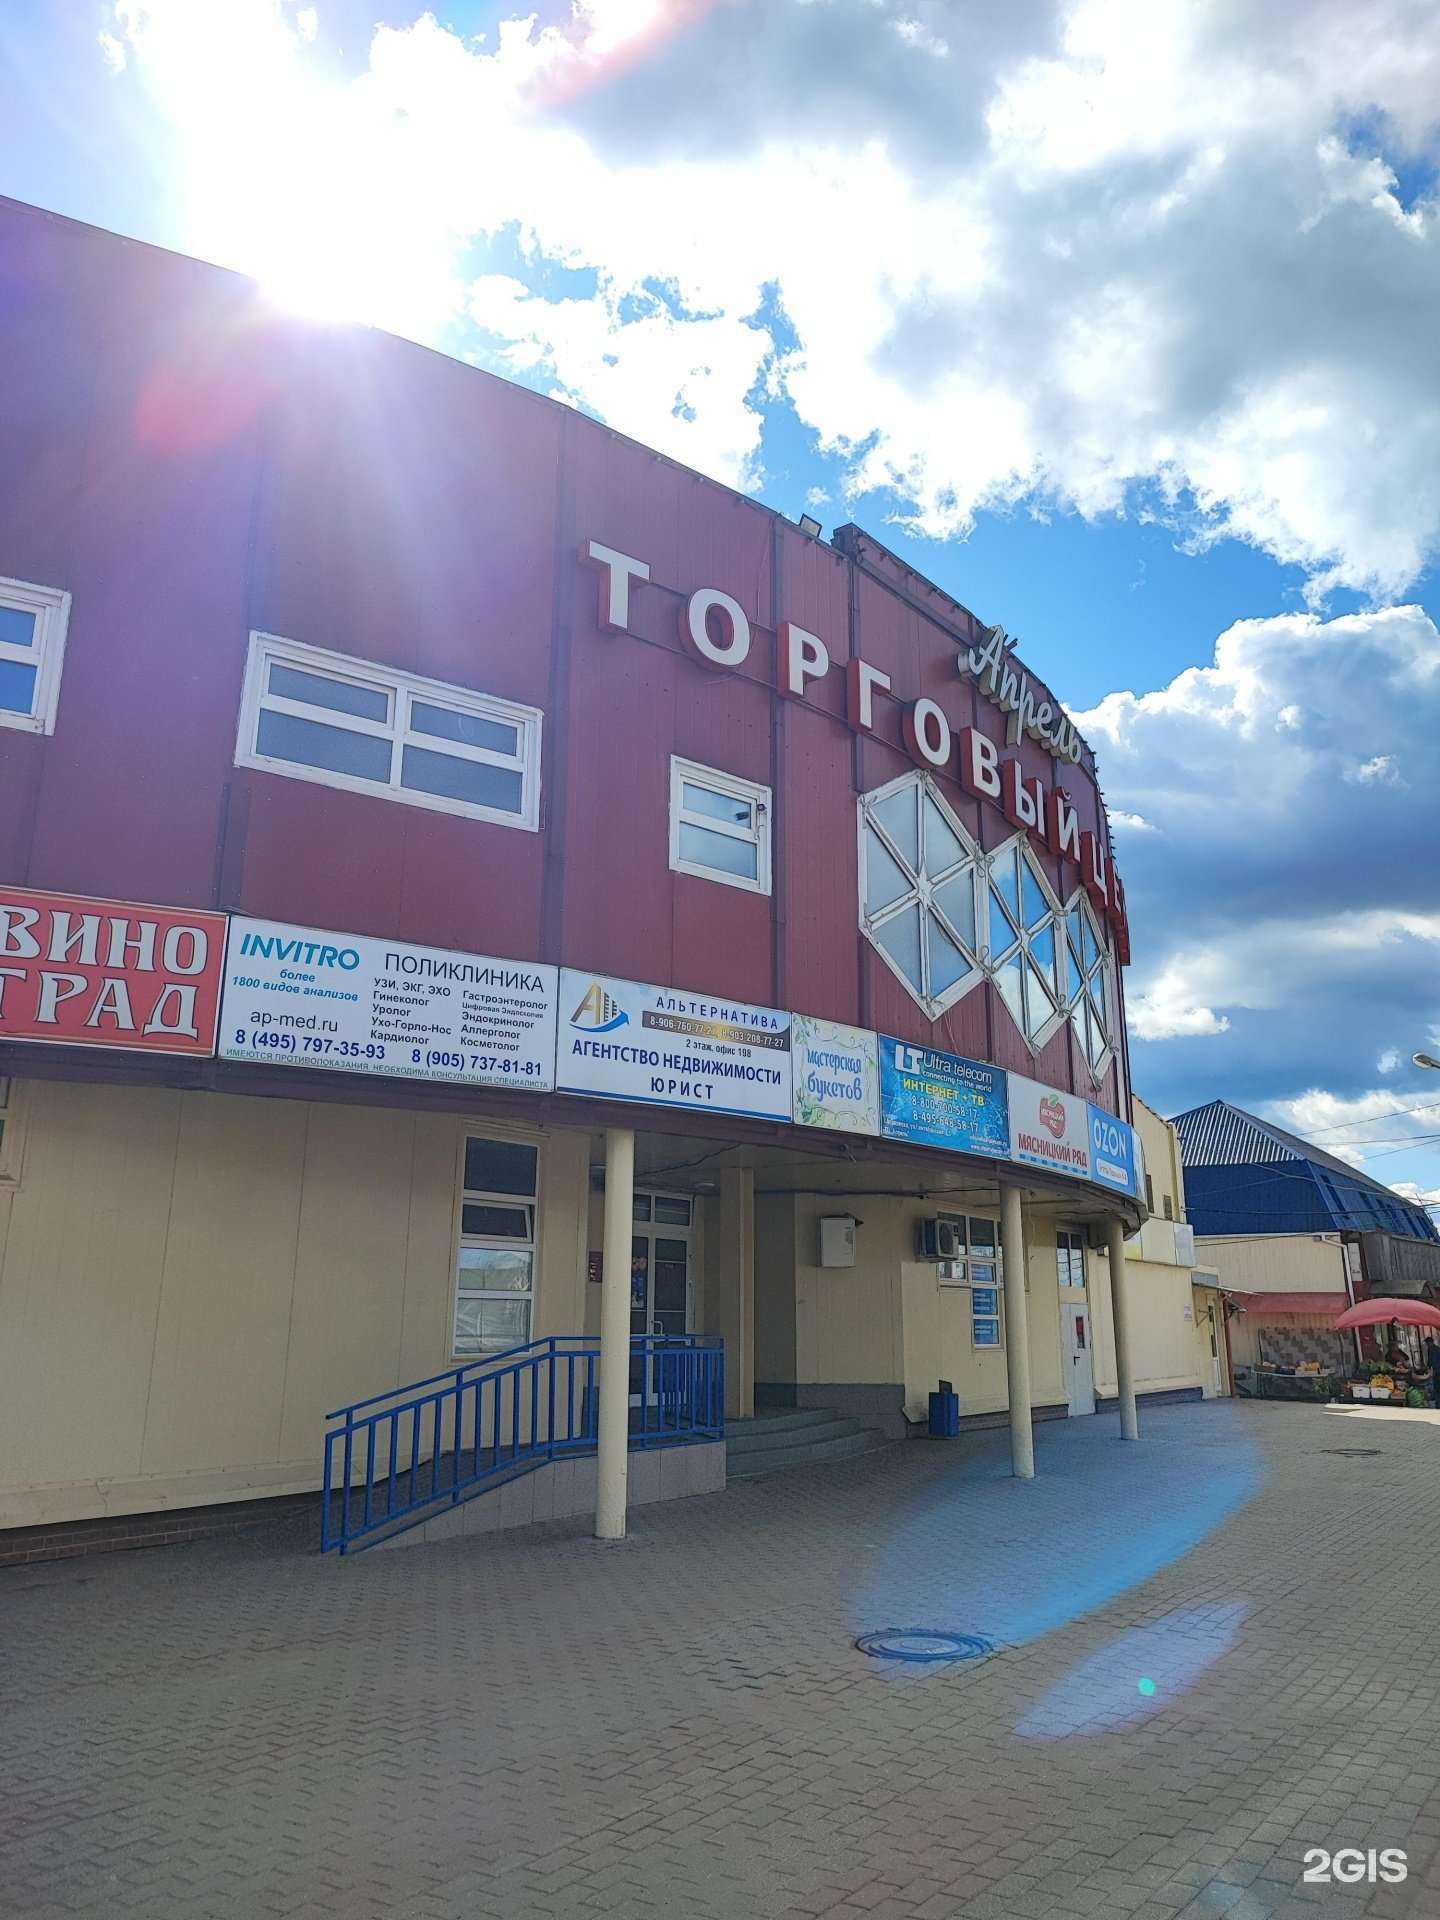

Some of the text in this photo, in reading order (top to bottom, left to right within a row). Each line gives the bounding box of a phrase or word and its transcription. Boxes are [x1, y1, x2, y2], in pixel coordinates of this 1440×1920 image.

[585, 540, 1081, 864] ТОРГОВЫЙ
[964, 624, 1082, 764] Апрель
[0, 904, 208, 976] ВИНО
[240, 933, 360, 970] INVITRO
[279, 968, 316, 983] более
[385, 953, 545, 993] ПОЛИКЛИНИКА
[232, 976, 359, 1002] 1800 видов анализов
[373, 990, 430, 1006] Гинеколог
[374, 977, 451, 997] УЗИ, ЭКГ, ЭХО
[463, 990, 548, 1010] Гастроэнтеролог
[372, 1003, 411, 1017] Уролог
[462, 1002, 500, 1014] Цифровая
[462, 1011, 535, 1029] Эндокринолог
[656, 996, 778, 1030] АЛЬТЕРНАТИВА
[250, 1010, 338, 1033] ap-med.ru
[371, 1016, 452, 1035] Ухо-Горло-Нос
[461, 1024, 521, 1040] Аллерголог
[235, 1029, 386, 1060] 8 (495) 797-35-93
[370, 1029, 430, 1045] Кардиолог
[460, 1036, 520, 1052] Косметолог
[686, 1038, 691, 1048] 2
[715, 1044, 736, 1056] офис
[226, 1048, 273, 1060] ИМЕЮТСЯ
[373, 1064, 430, 1077] НЕОБХОДИМА
[431, 1070, 493, 1083] КОНСУЛЬТАЦИЯ
[494, 1076, 548, 1089] СПЕЦИАЛИСТА
[411, 1049, 542, 1076] 8 (905) 737-81-81
[572, 1039, 781, 1085] АГЕНТСТВО НЕДВИЖИМОСТИ
[923, 1053, 992, 1084] Ultra telecom
[651, 1077, 714, 1099] ЮРИСТ
[807, 1071, 863, 1102] букетов
[903, 1078, 959, 1100] ИНТЕРНЕТ
[971, 1094, 985, 1107] ТВ
[922, 1070, 956, 1085] connecting
[964, 1080, 974, 1088] the
[975, 1083, 992, 1093] world
[1018, 1133, 1071, 1163] МЯСНИЦКИЙ
[1072, 1147, 1088, 1168] РЯД
[1093, 1118, 1128, 1161] OZON
